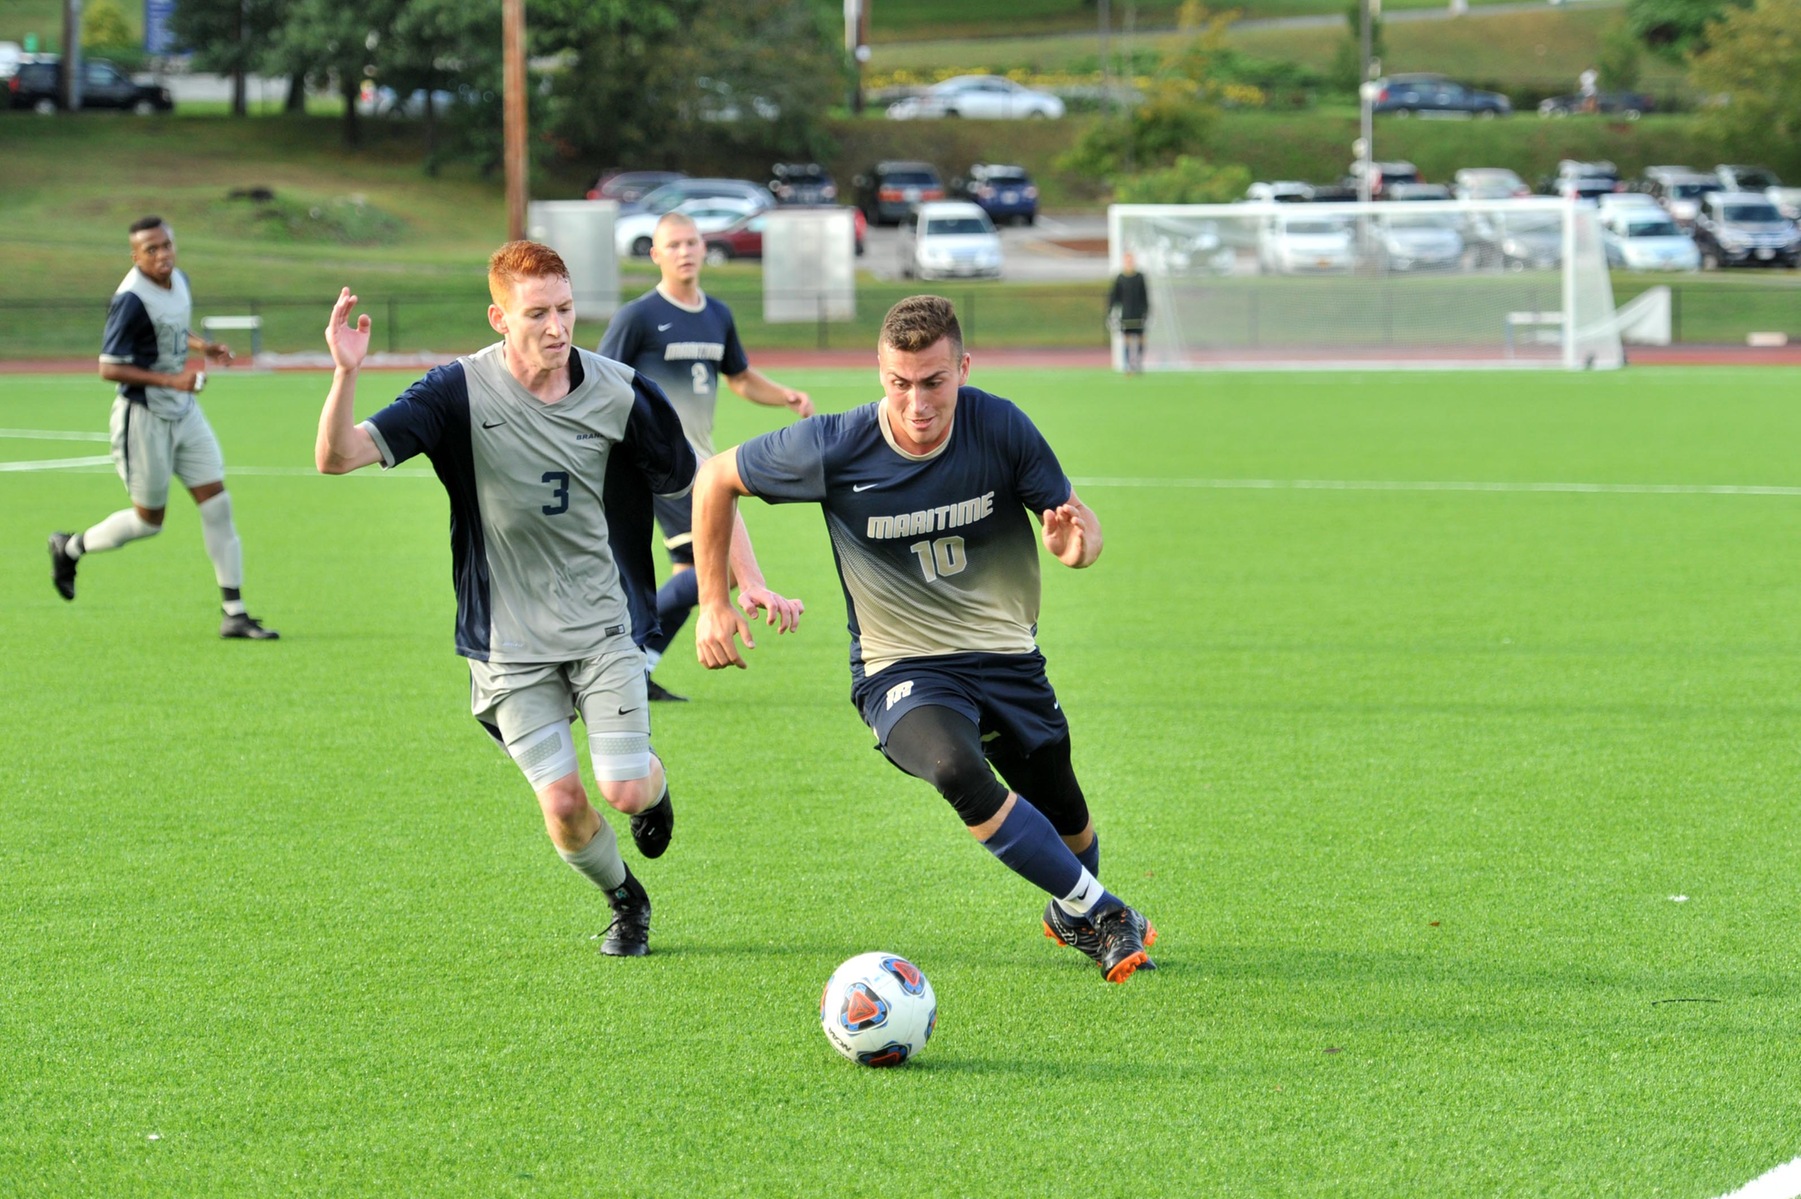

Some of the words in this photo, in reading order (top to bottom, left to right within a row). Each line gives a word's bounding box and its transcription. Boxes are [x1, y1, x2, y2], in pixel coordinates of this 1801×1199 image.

[691, 362, 710, 394] 2
[541, 471, 570, 516] 3
[867, 491, 995, 539] MARITIME
[910, 535, 967, 583] 10
